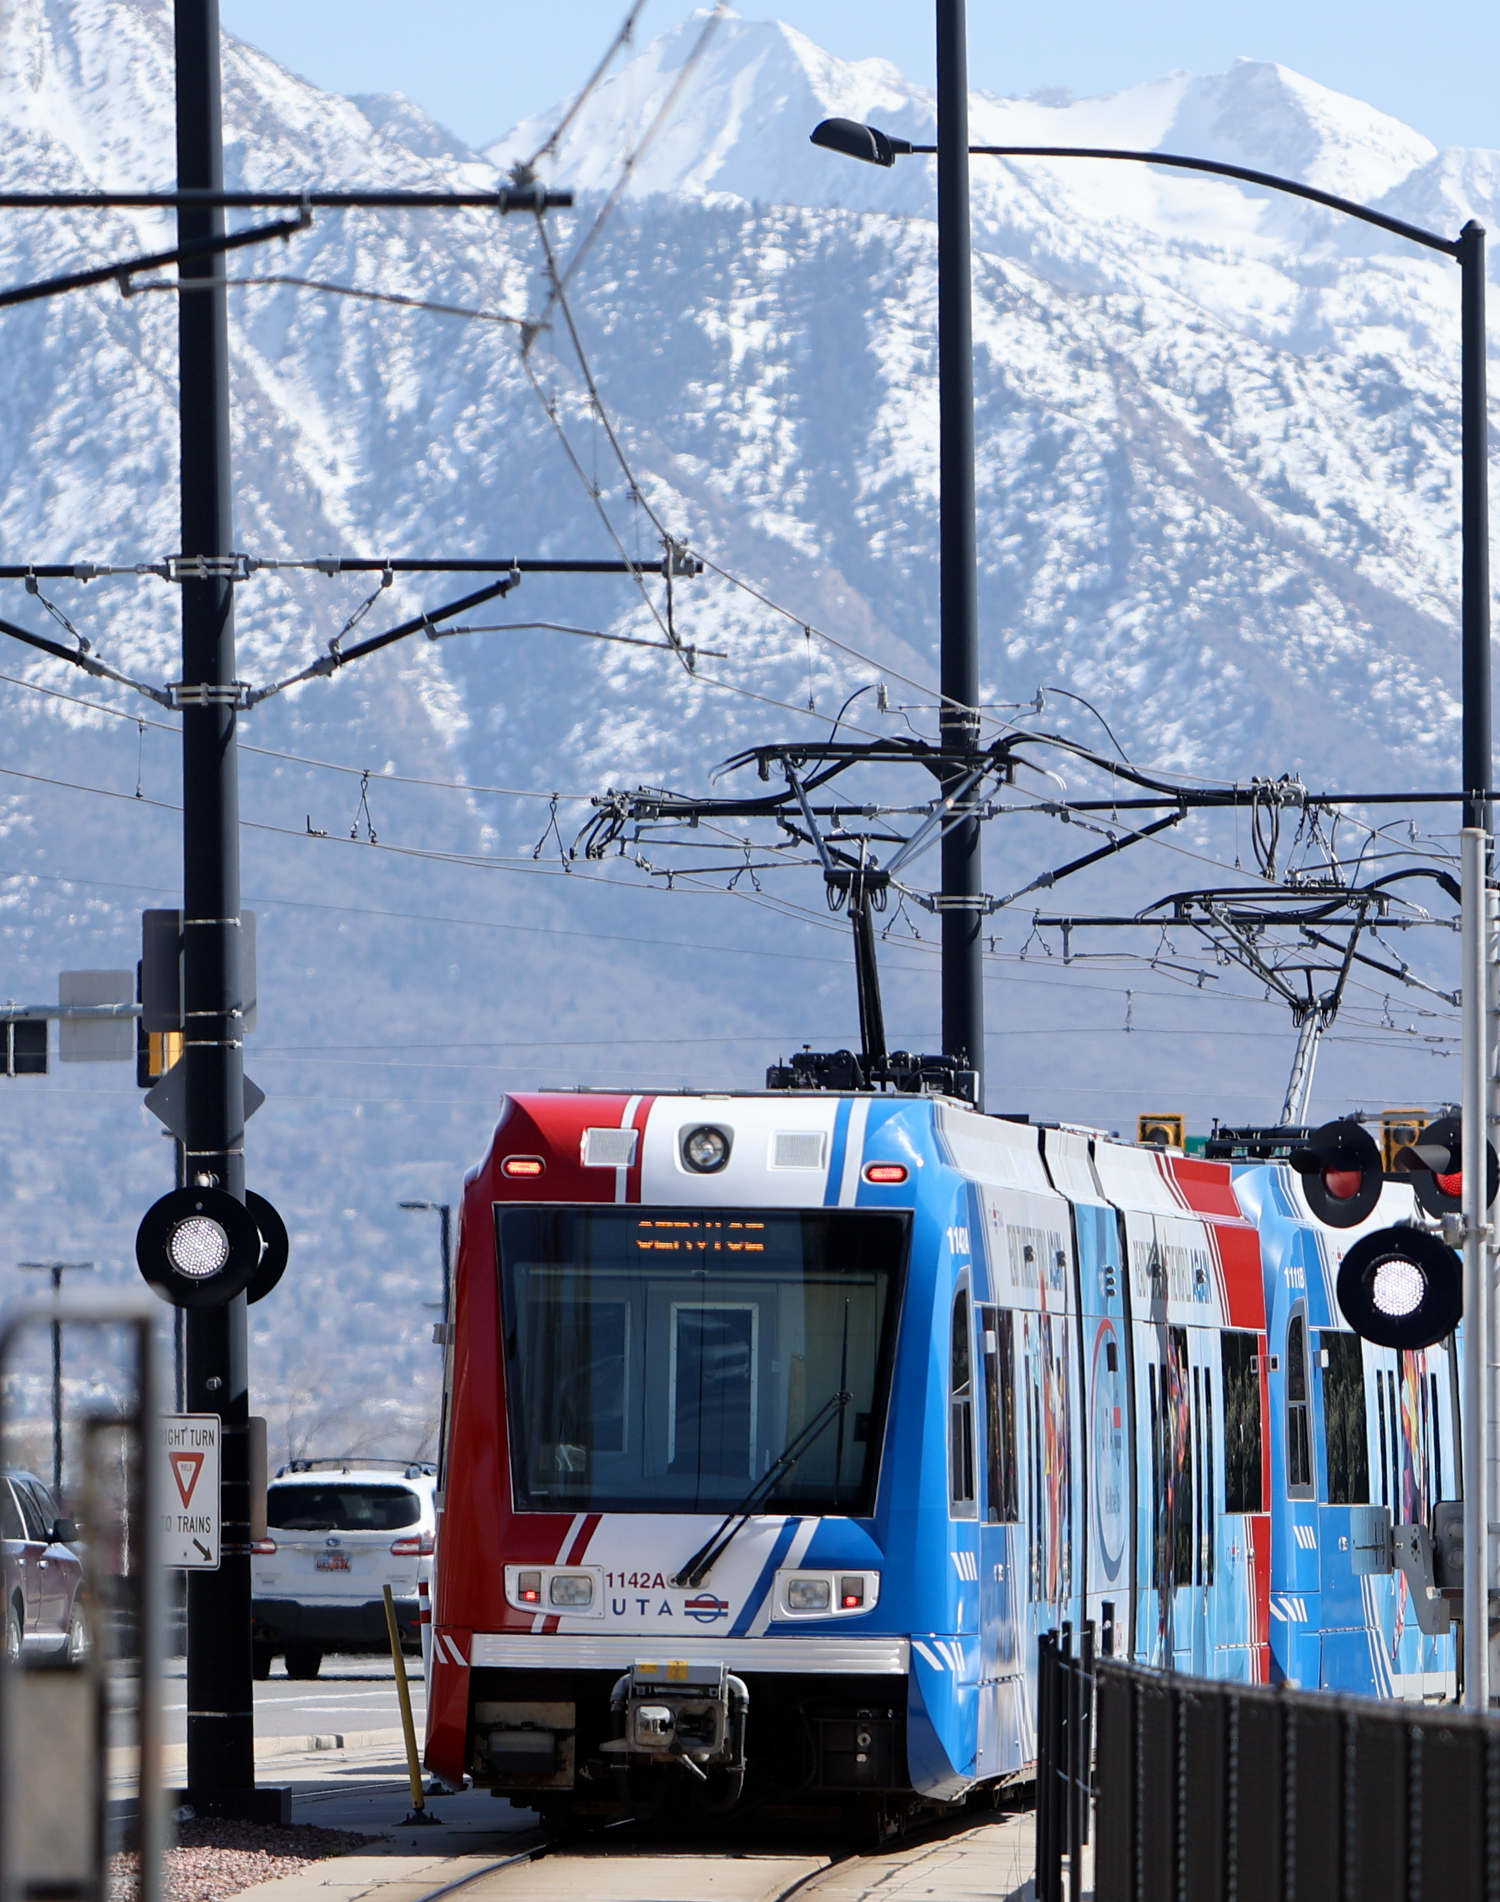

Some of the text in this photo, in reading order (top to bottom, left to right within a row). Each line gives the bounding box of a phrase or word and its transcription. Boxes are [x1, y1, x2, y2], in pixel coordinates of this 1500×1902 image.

[190, 1429, 215, 1447] TURN
[180, 1463, 193, 1472] YIELD
[177, 1516, 212, 1534] TRAINS
[606, 1571, 666, 1590] 1142A
[612, 1598, 673, 1617] UTA
